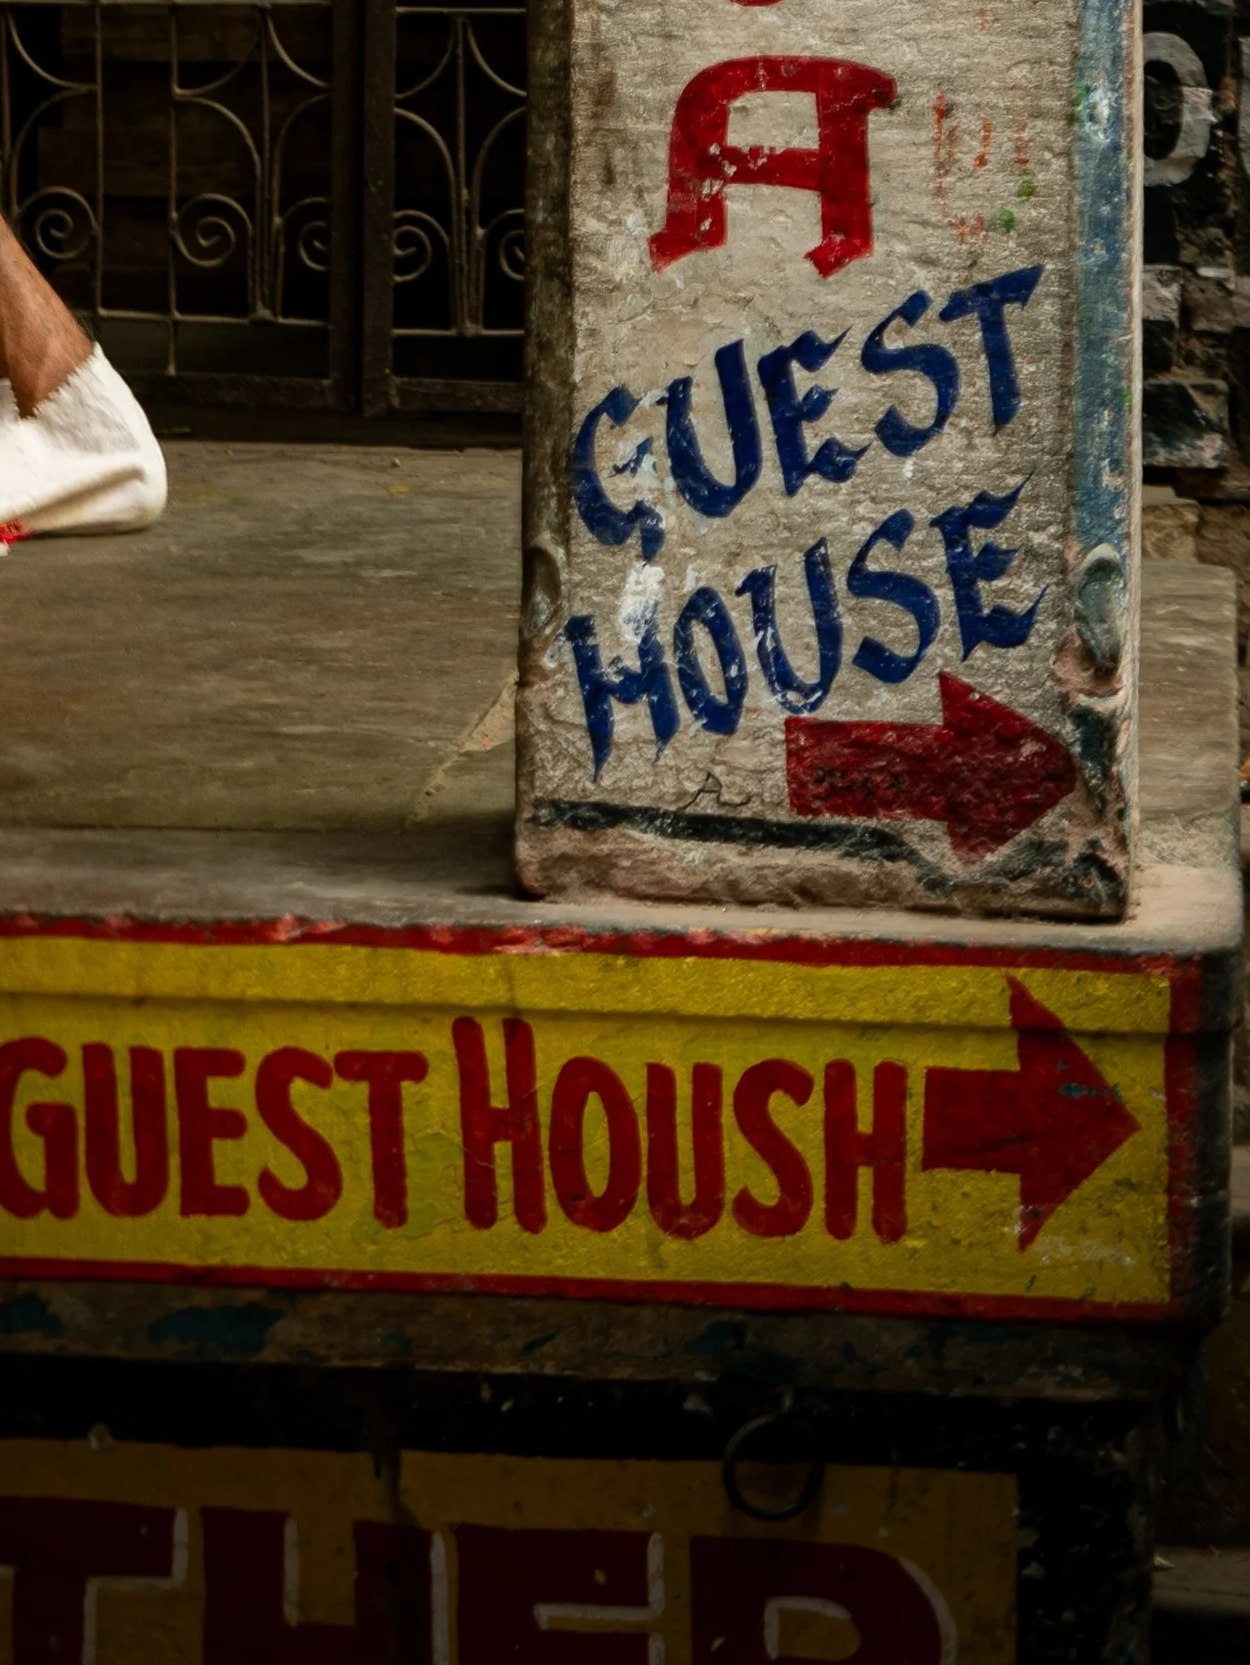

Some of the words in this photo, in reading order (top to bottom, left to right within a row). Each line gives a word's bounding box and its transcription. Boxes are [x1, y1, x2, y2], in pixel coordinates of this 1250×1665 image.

[569, 263, 1044, 560] GUEST
[564, 469, 1048, 781] HOUSE
[451, 1016, 909, 1243] HOUSH
